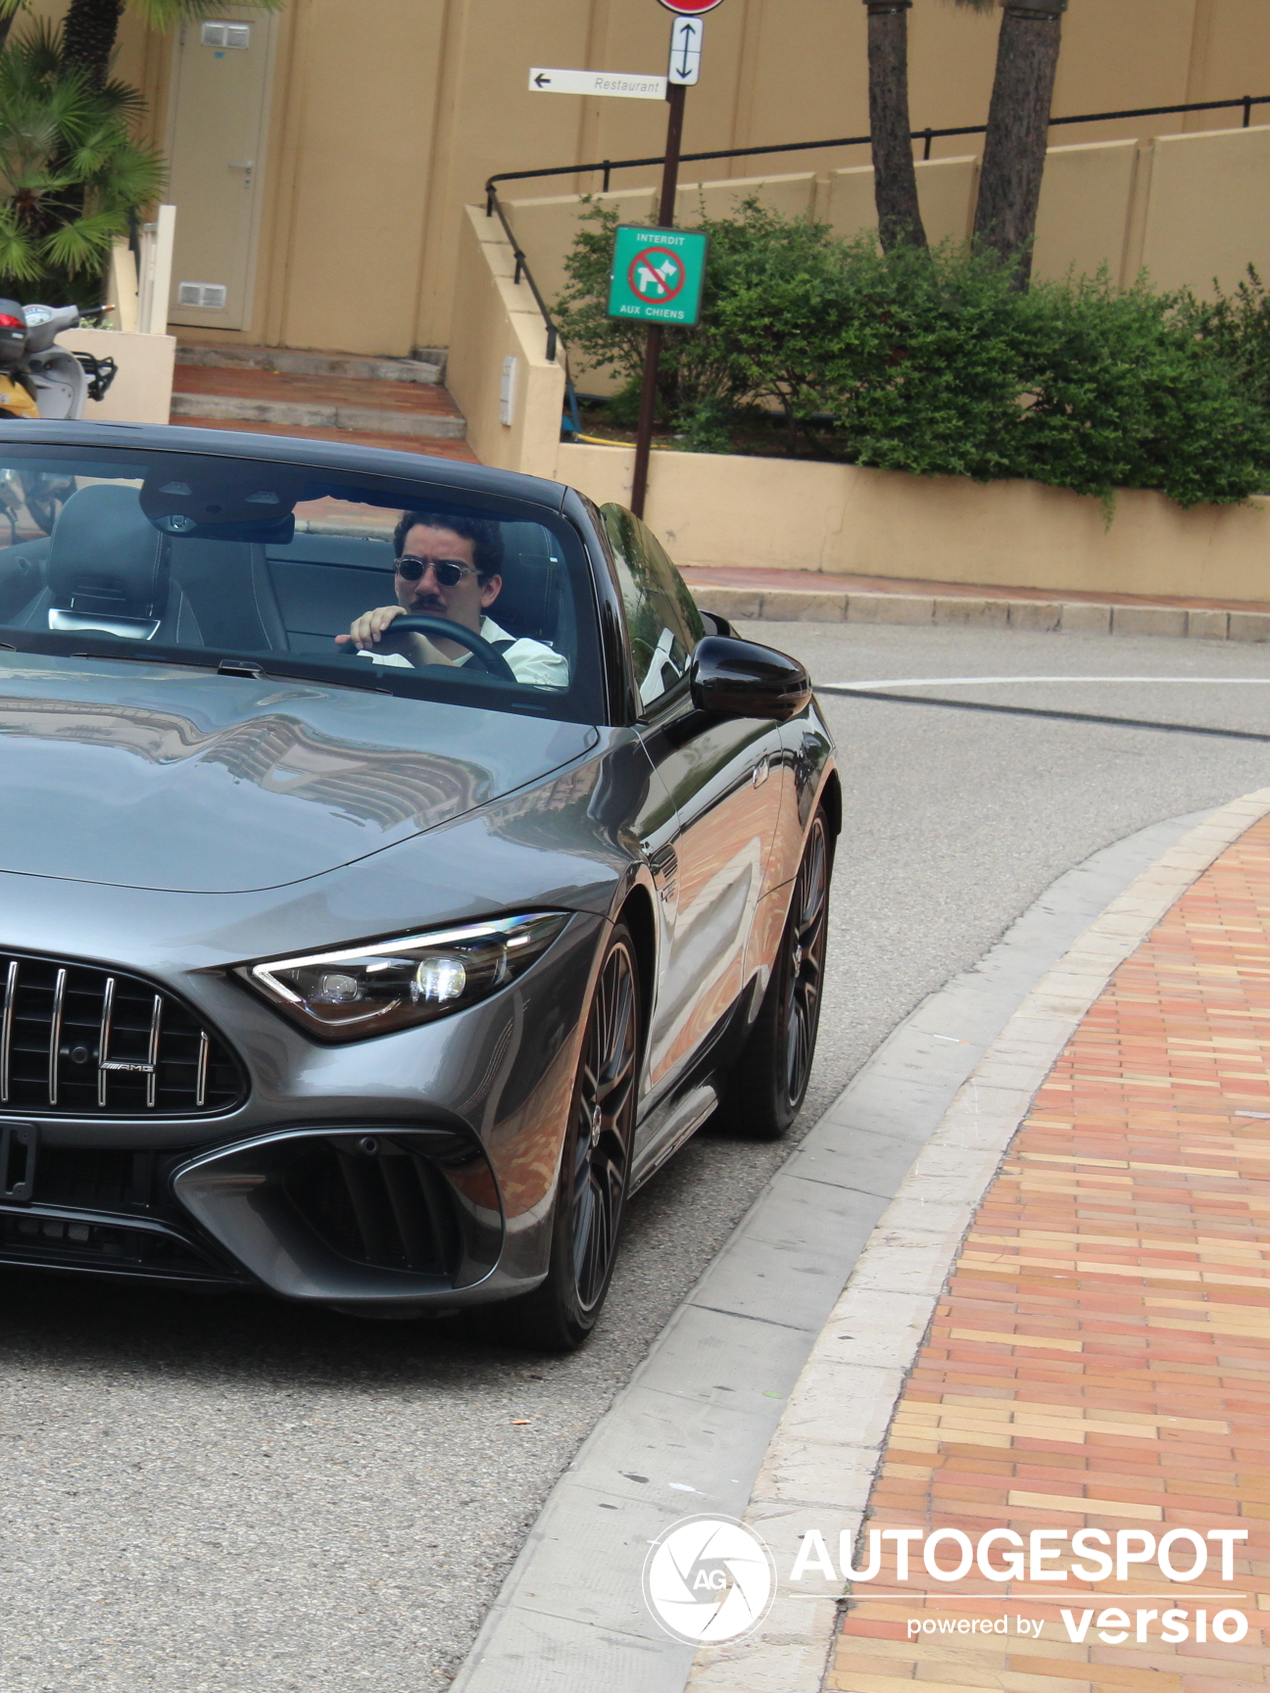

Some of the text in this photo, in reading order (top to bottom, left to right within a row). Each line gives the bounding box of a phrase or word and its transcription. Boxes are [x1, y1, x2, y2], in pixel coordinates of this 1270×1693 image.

[594, 77, 660, 94] Restaurant
[636, 233, 686, 246] INTERDIT
[619, 304, 685, 320] AUX CHIENS
[117, 1063, 154, 1073] AMG
